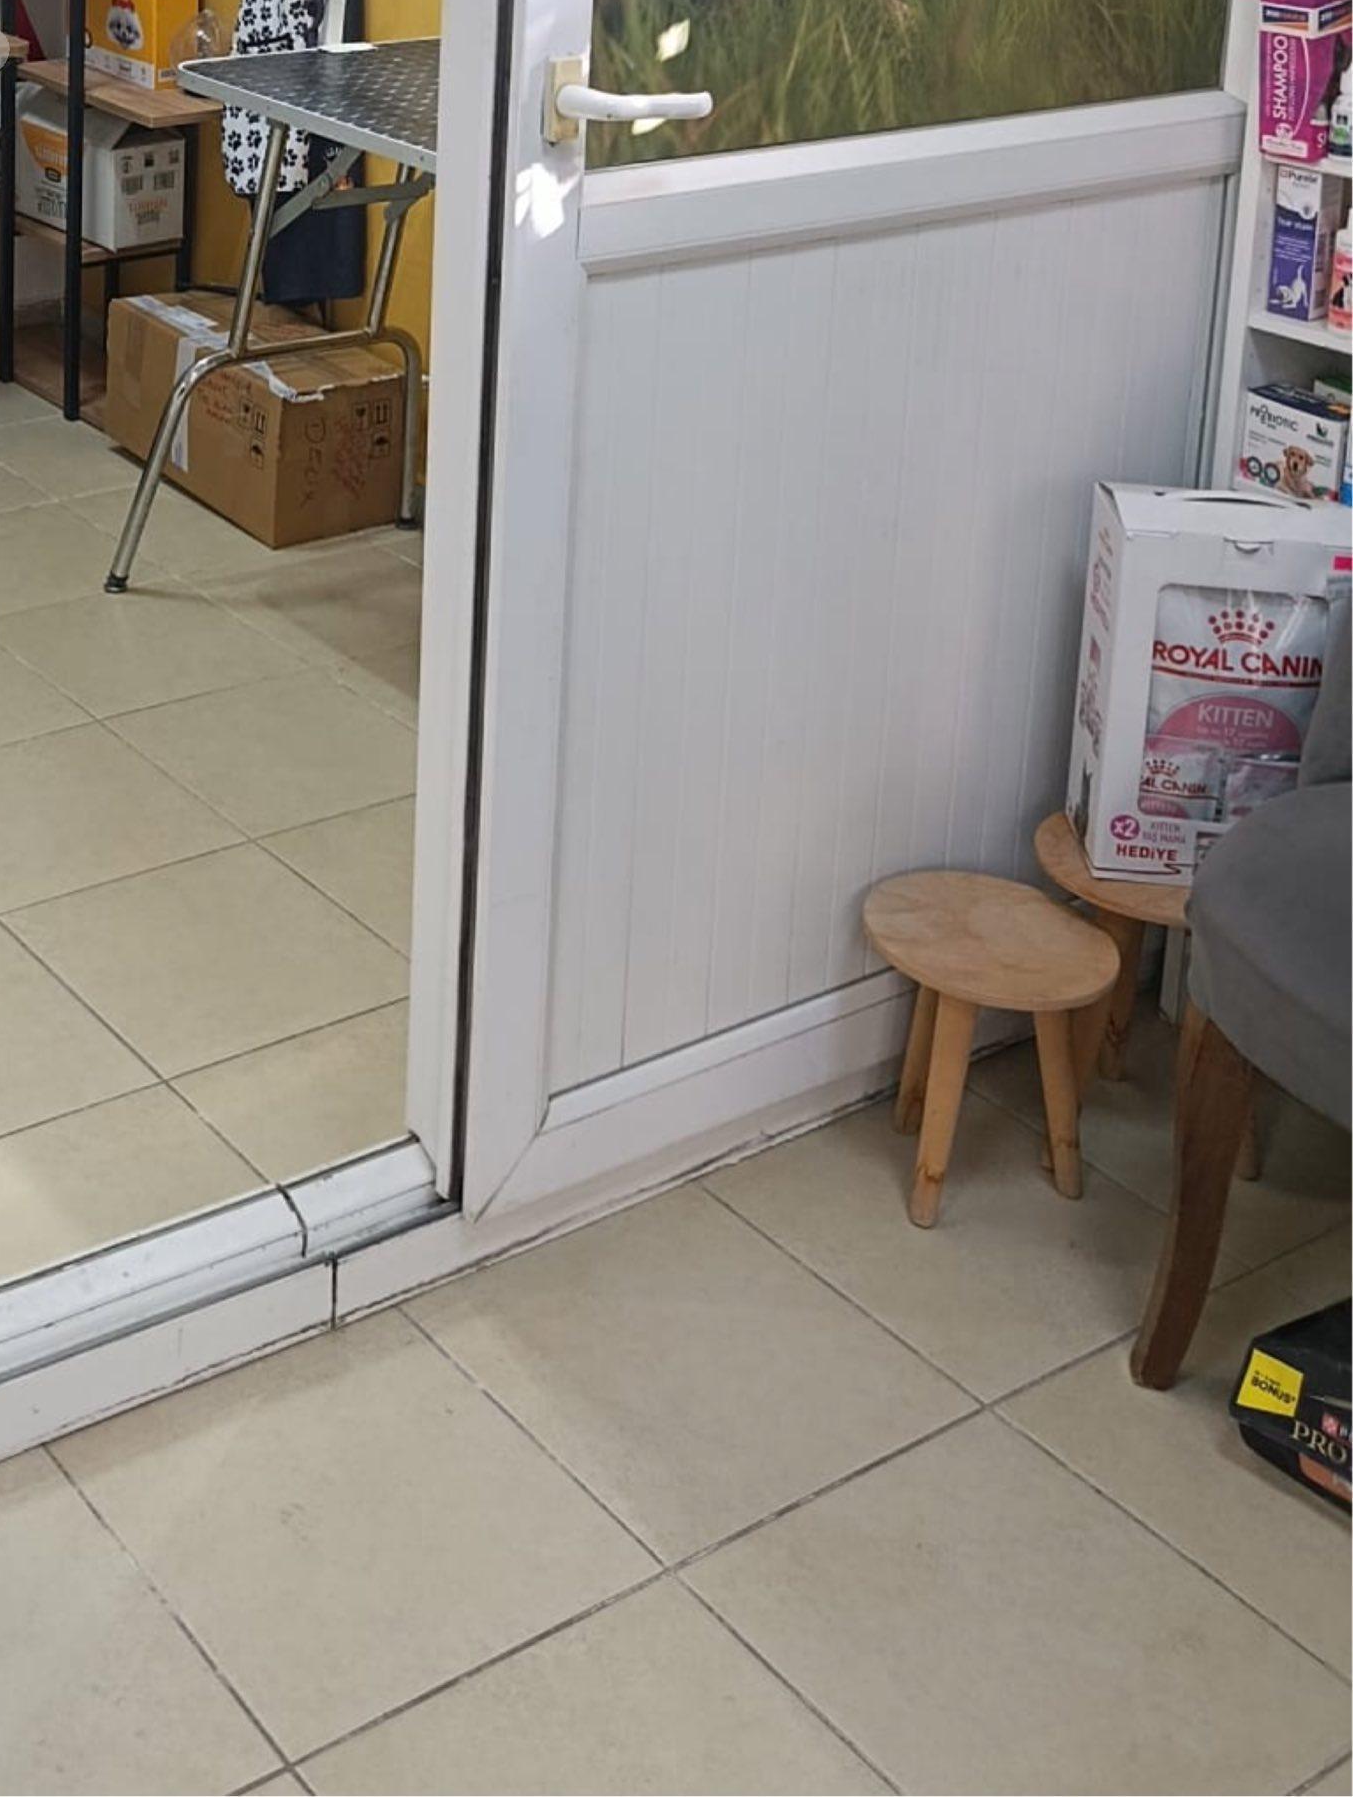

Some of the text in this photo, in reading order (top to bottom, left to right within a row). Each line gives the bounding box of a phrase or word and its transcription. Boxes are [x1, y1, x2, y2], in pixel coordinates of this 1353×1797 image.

[1272, 34, 1289, 120] SHAMPOO
[1152, 640, 1323, 678] ROYAL CANIN
[1197, 703, 1275, 729] KITTEN
[1291, 1419, 1348, 1465] PRO
